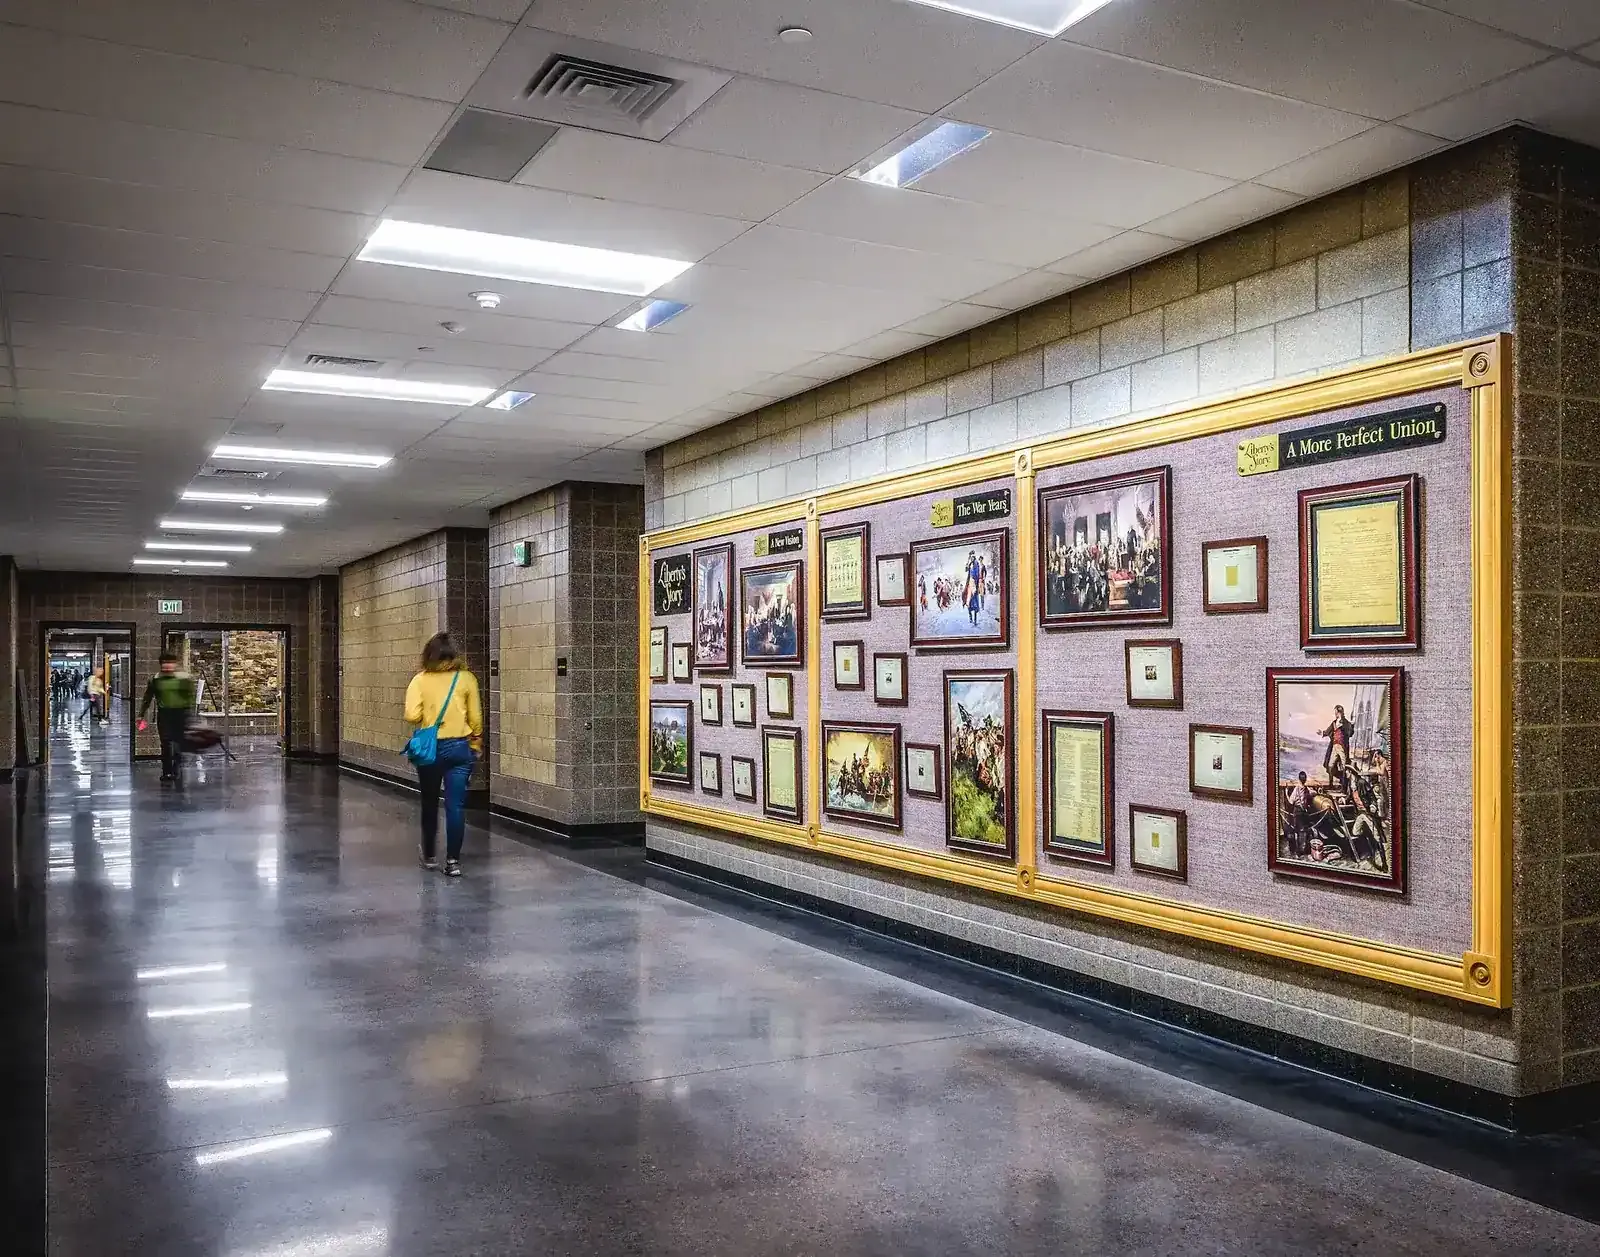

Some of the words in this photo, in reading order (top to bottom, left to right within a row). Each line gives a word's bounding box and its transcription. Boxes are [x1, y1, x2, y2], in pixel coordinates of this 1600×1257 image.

[1286, 441, 1297, 459] A
[1299, 438, 1333, 457] More
[1336, 426, 1385, 450] Perfect
[1389, 418, 1437, 440] Union
[956, 503, 971, 517] The
[972, 501, 987, 514] War
[988, 498, 1008, 512] Years
[785, 534, 800, 546] Vision
[162, 601, 180, 613] EXIT
